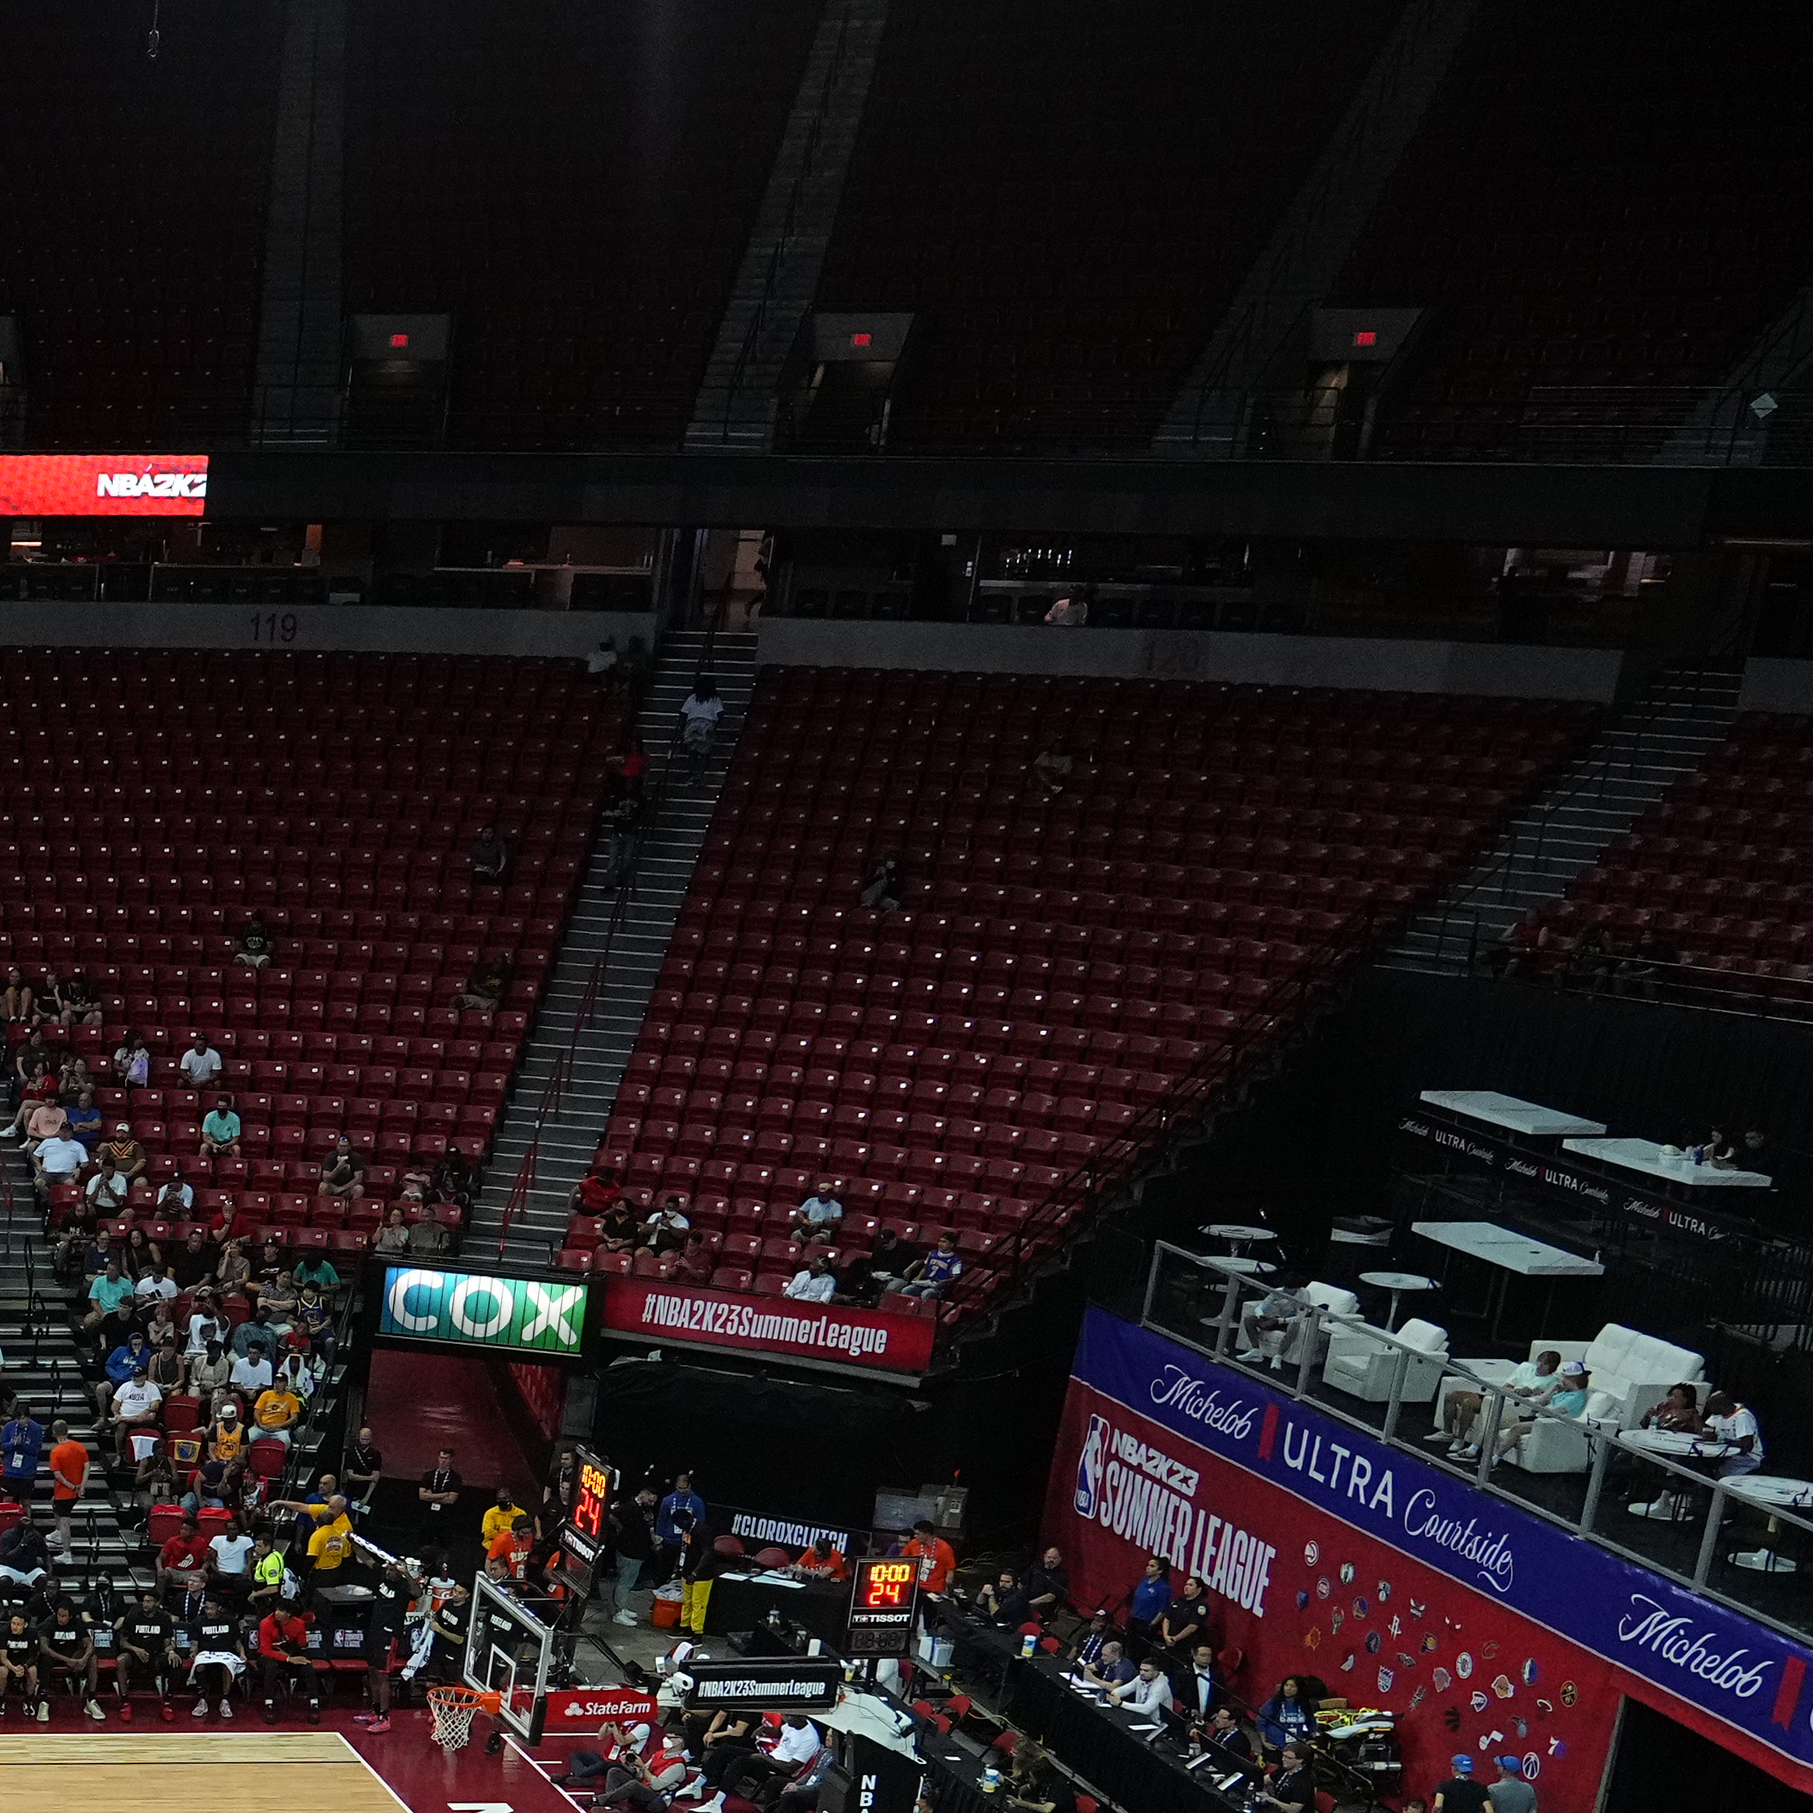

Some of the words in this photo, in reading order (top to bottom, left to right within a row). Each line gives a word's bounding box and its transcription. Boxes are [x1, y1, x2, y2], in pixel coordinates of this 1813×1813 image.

[251, 612, 297, 643] 119
[1435, 1130, 1466, 1153] ULTRA
[1544, 1168, 1578, 1192] ULTRA
[1668, 1211, 1706, 1236] ULTRA
[387, 1266, 585, 1346] COX
[642, 1292, 889, 1358] #NBA2K23SummerLeague
[1111, 1428, 1200, 1497] NBA2K23
[1150, 1363, 1261, 1440] Michelob
[1283, 1422, 1394, 1518] ULTRA
[1404, 1488, 1514, 1592] Courtside
[581, 1464, 606, 1498] 10:00
[575, 1487, 601, 1535] 24
[1099, 1460, 1191, 1572] SUMMER
[1190, 1508, 1277, 1619] LEAGUE
[870, 1565, 910, 1582] 10:00
[869, 1583, 900, 1604] 24
[869, 1614, 910, 1623] TISSOT
[1618, 1594, 1775, 1698] Michelob
[698, 1680, 825, 1698] #NBA2K23SummerLeague
